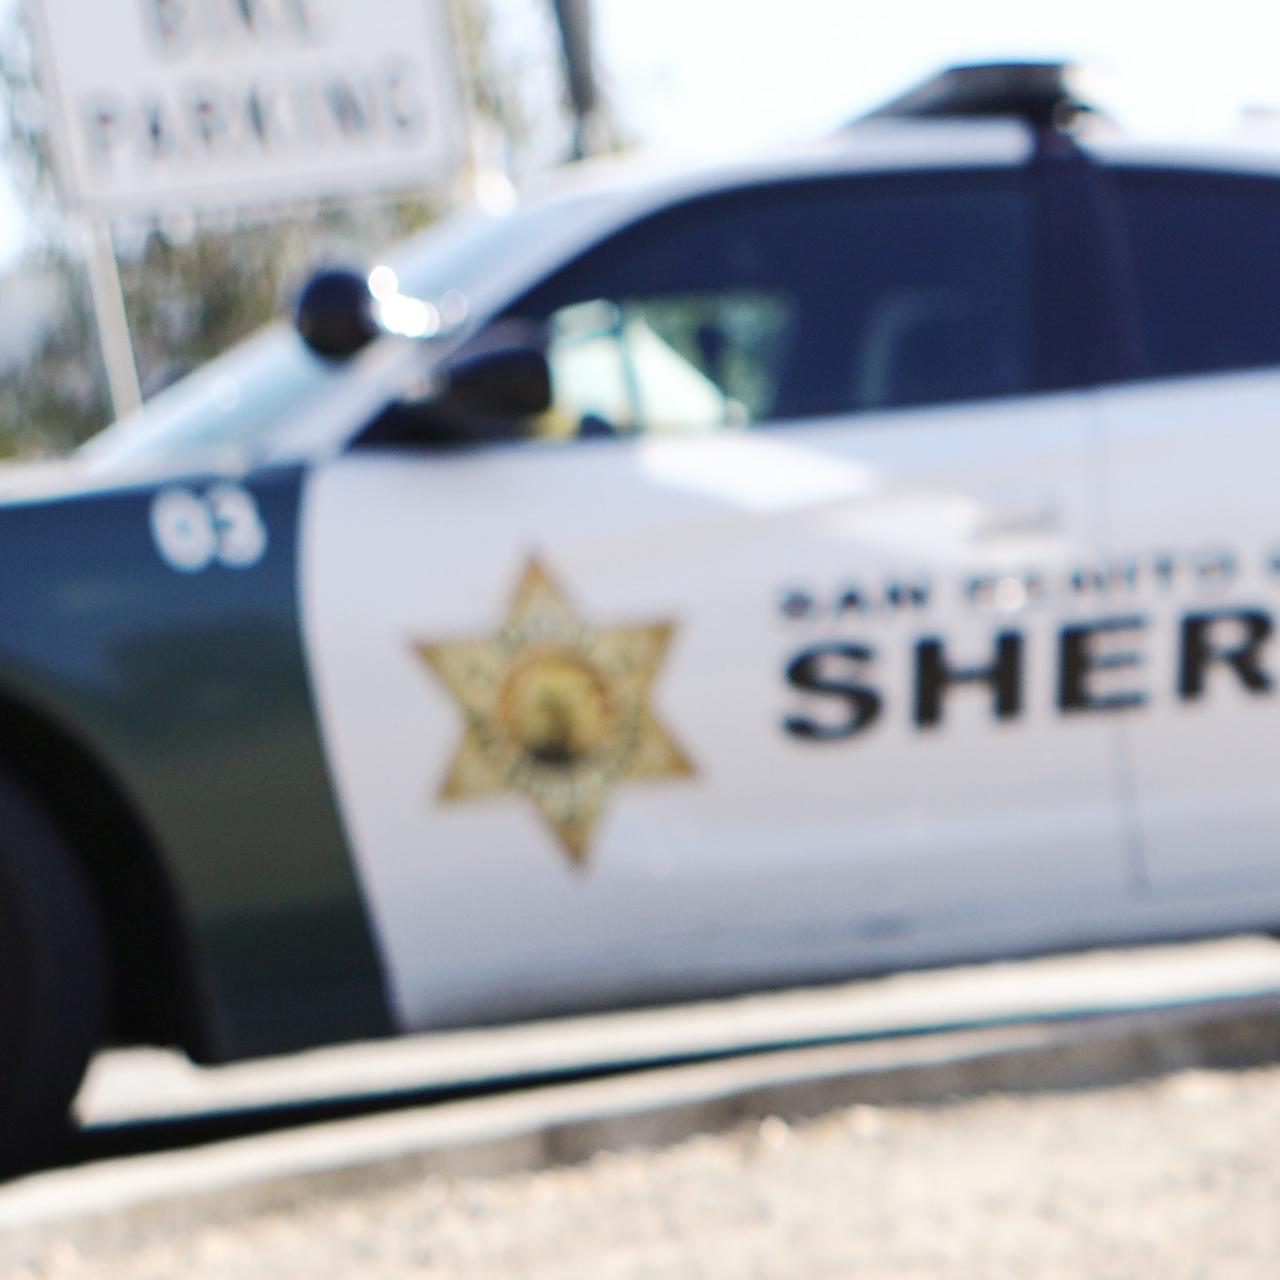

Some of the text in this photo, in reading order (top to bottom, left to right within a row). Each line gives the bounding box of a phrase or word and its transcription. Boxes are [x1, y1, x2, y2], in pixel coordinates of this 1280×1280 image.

[80, 53, 430, 180] PARKING
[150, 485, 267, 572] 03
[779, 580, 932, 620] SAN
